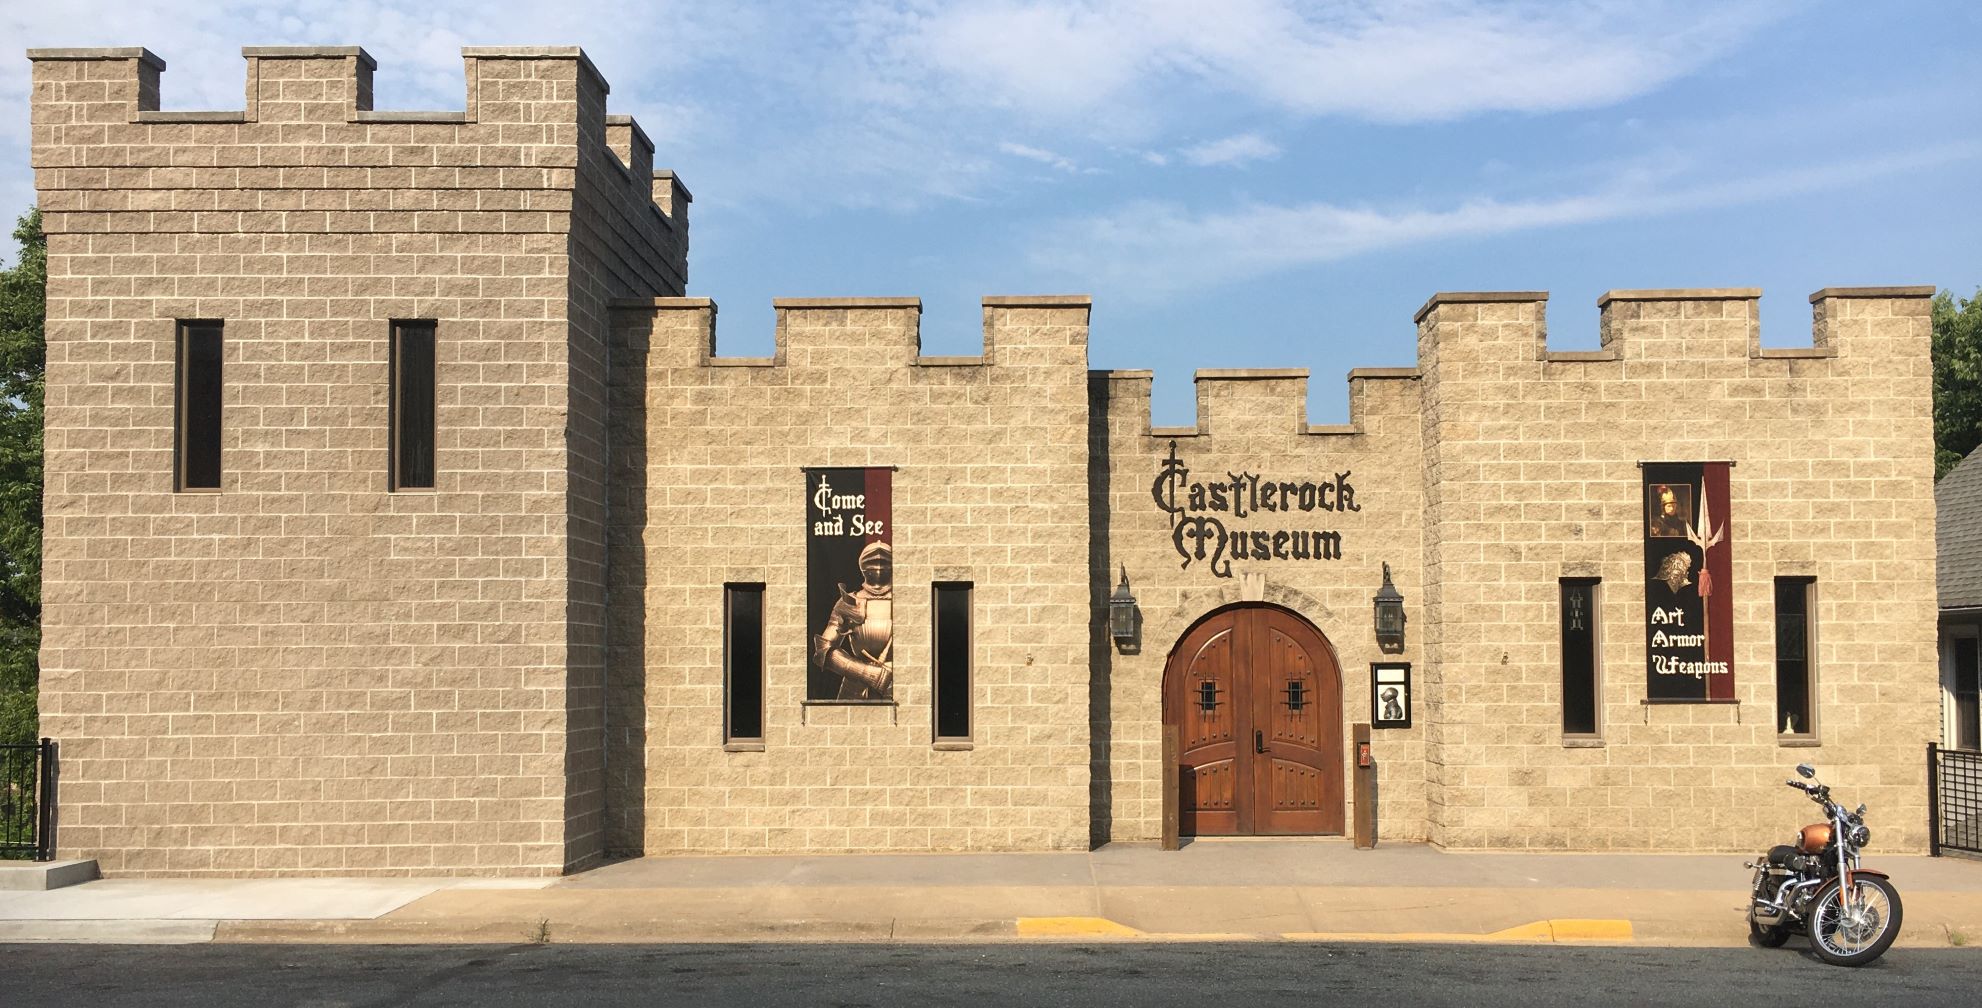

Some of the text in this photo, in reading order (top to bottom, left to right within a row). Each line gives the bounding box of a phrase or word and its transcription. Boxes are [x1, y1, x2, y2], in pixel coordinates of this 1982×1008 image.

[814, 479, 865, 517] Come
[1152, 454, 1361, 522] Castlerock
[814, 514, 884, 536] and See
[1172, 516, 1342, 578] Museum
[1651, 606, 1685, 627] Art
[1651, 630, 1706, 648] Armor
[1652, 654, 1729, 679] Weapons
